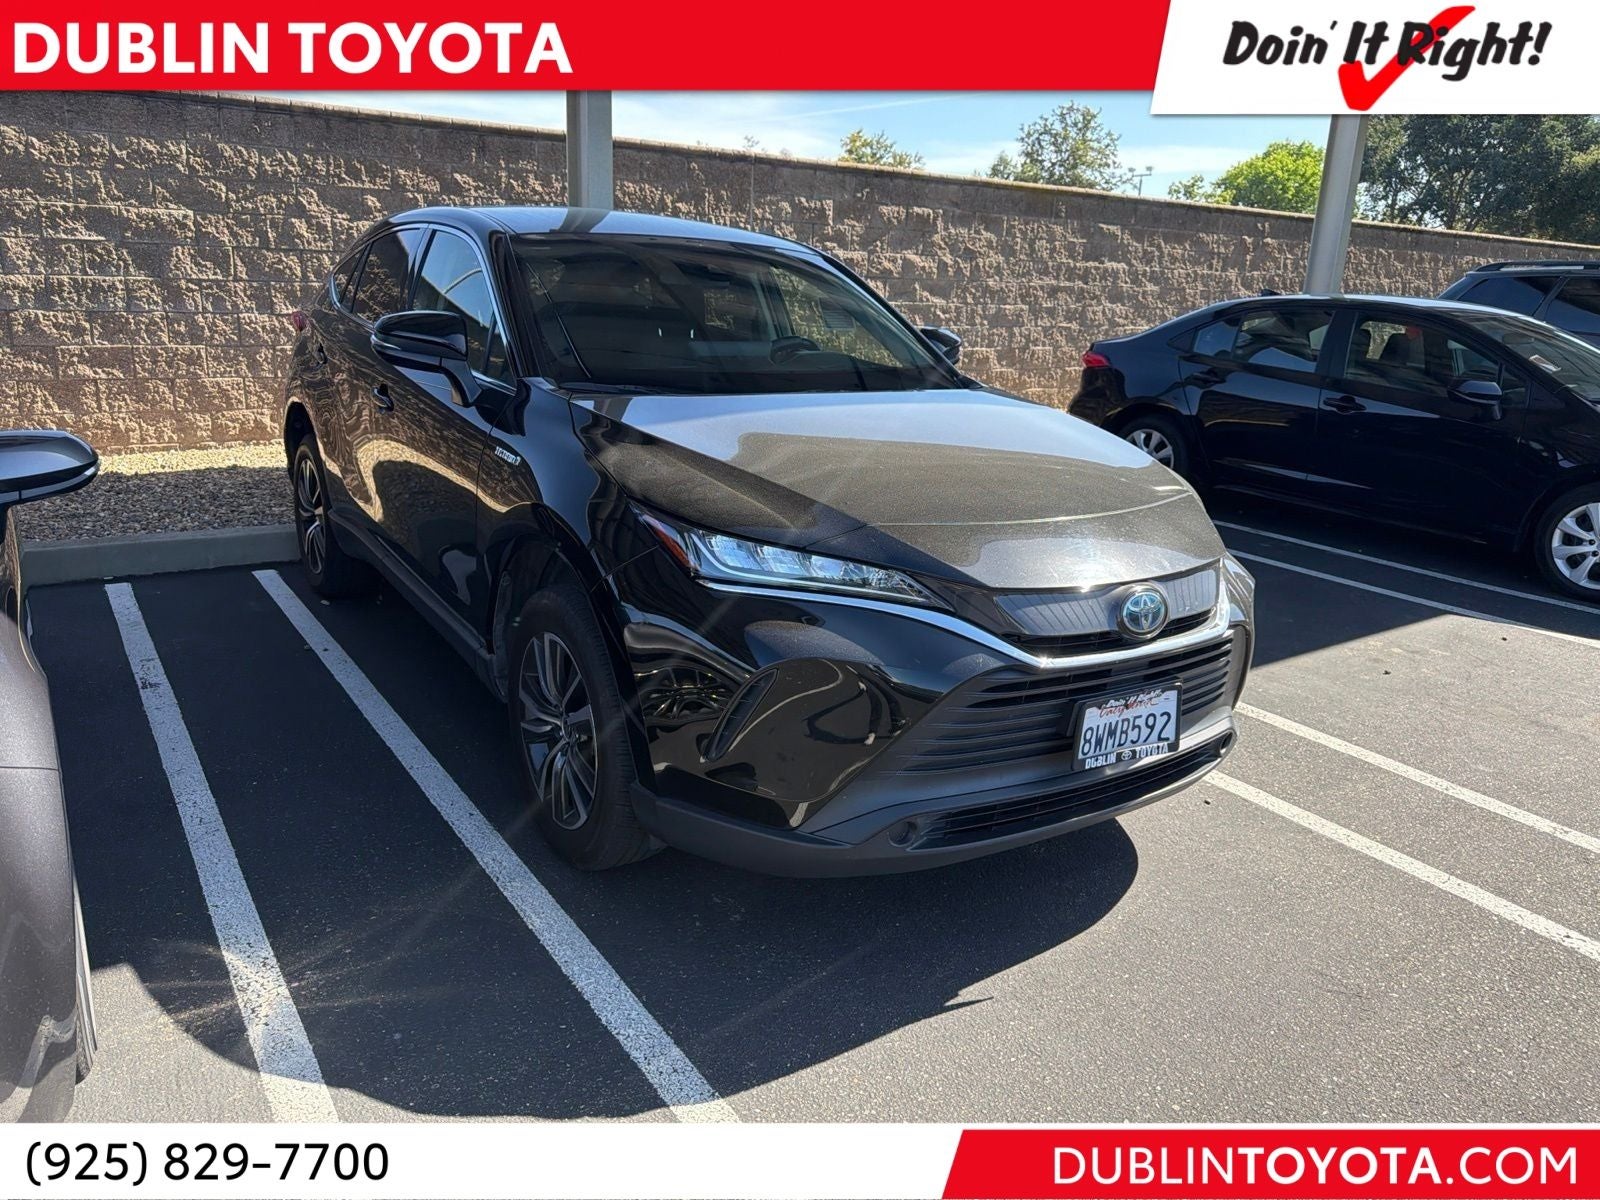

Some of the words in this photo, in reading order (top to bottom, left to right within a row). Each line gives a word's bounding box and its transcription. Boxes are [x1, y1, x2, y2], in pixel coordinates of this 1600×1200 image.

[1081, 711, 1172, 756] 8WMB592
[1085, 752, 1117, 769] DUBLIN
[1135, 743, 1169, 758] TOYOTA
